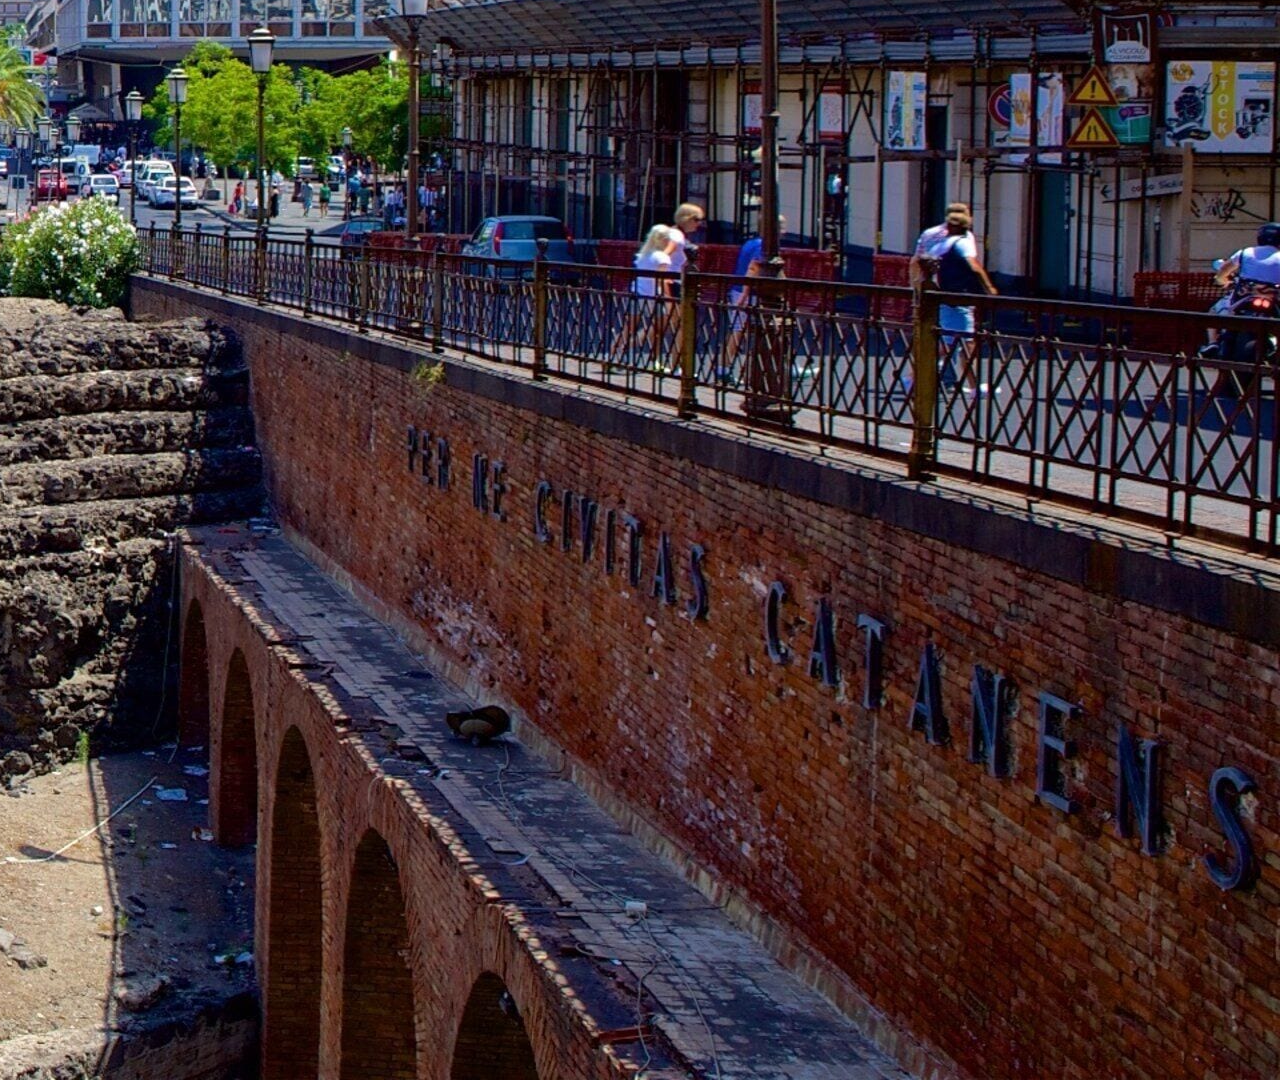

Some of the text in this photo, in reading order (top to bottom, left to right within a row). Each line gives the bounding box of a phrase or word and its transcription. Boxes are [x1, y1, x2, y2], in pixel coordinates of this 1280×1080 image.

[1218, 65, 1229, 133] STOCK
[407, 424, 449, 489] PER
[534, 480, 709, 622] CIVITAS
[763, 580, 1257, 892] CATANENS
